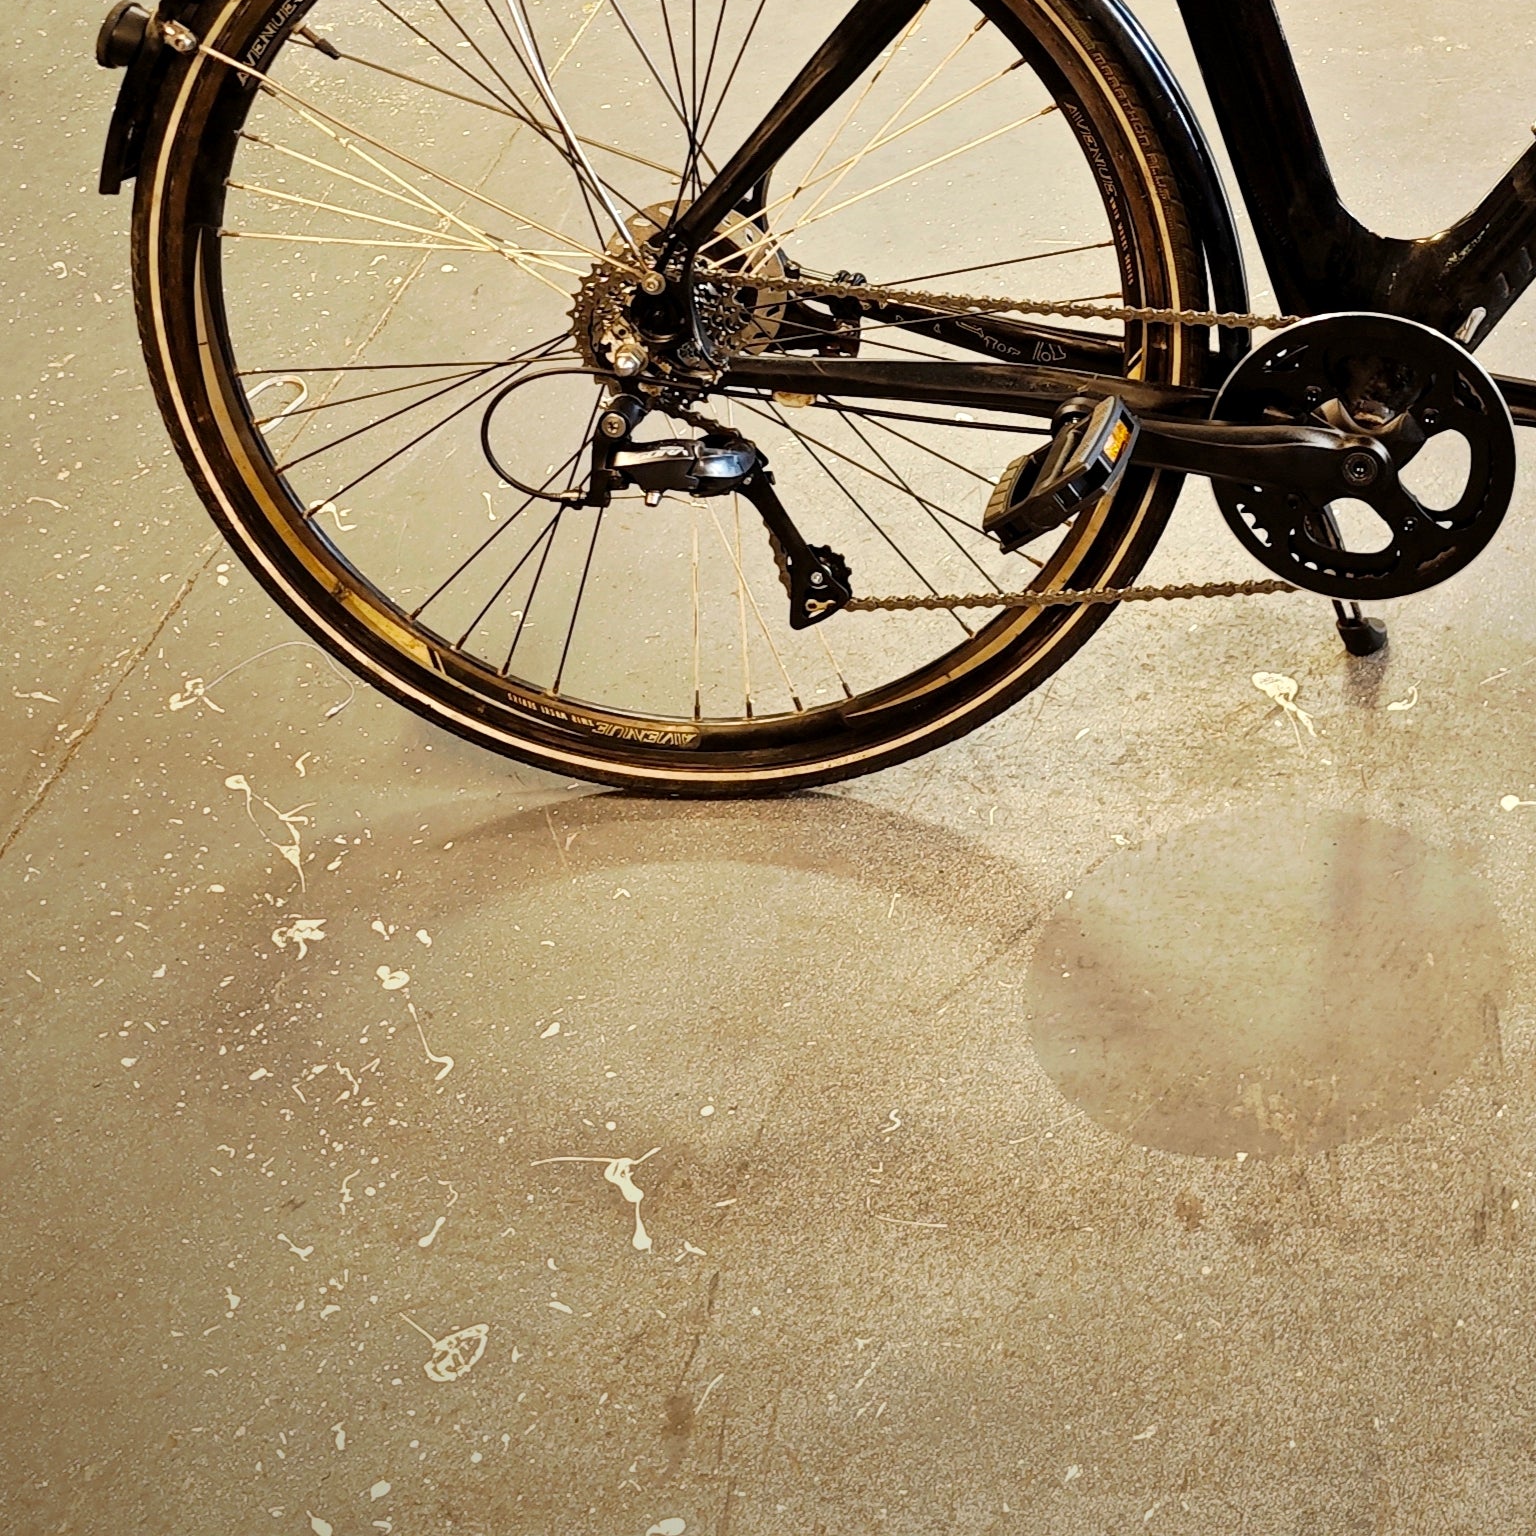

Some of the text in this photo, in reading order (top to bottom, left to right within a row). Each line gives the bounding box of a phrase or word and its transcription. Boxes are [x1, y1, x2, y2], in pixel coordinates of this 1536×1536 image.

[1092, 52, 1151, 160] MARATHON
[1064, 101, 1119, 198] AVENUE
[507, 692, 538, 712] SERIES
[592, 721, 698, 746] AVENUE
